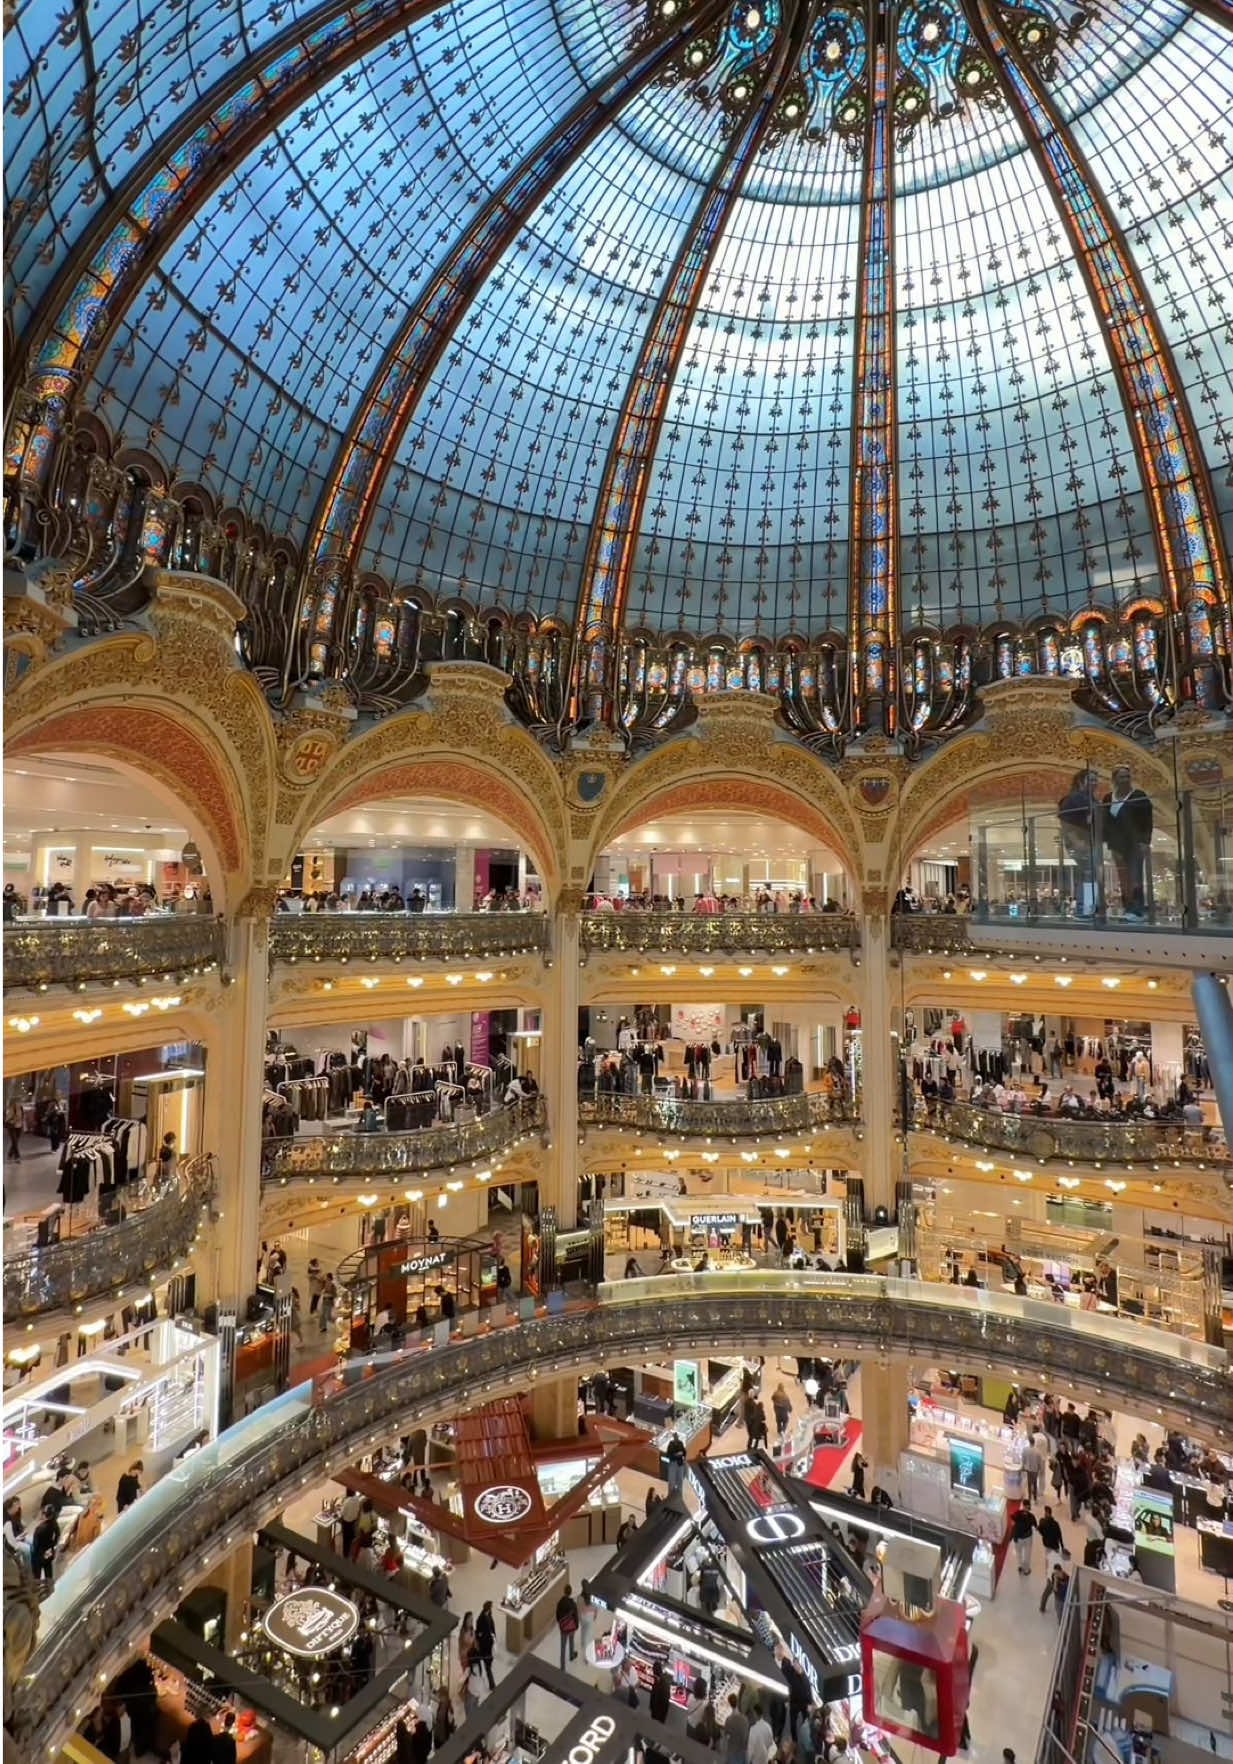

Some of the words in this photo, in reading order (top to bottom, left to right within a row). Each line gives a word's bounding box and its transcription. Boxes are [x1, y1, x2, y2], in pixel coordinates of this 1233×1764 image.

[692, 1214, 736, 1223] GUERLAIN
[400, 1253, 446, 1274] MOYNAT
[708, 1454, 752, 1470] DIOR
[561, 1715, 616, 1764] ORD
